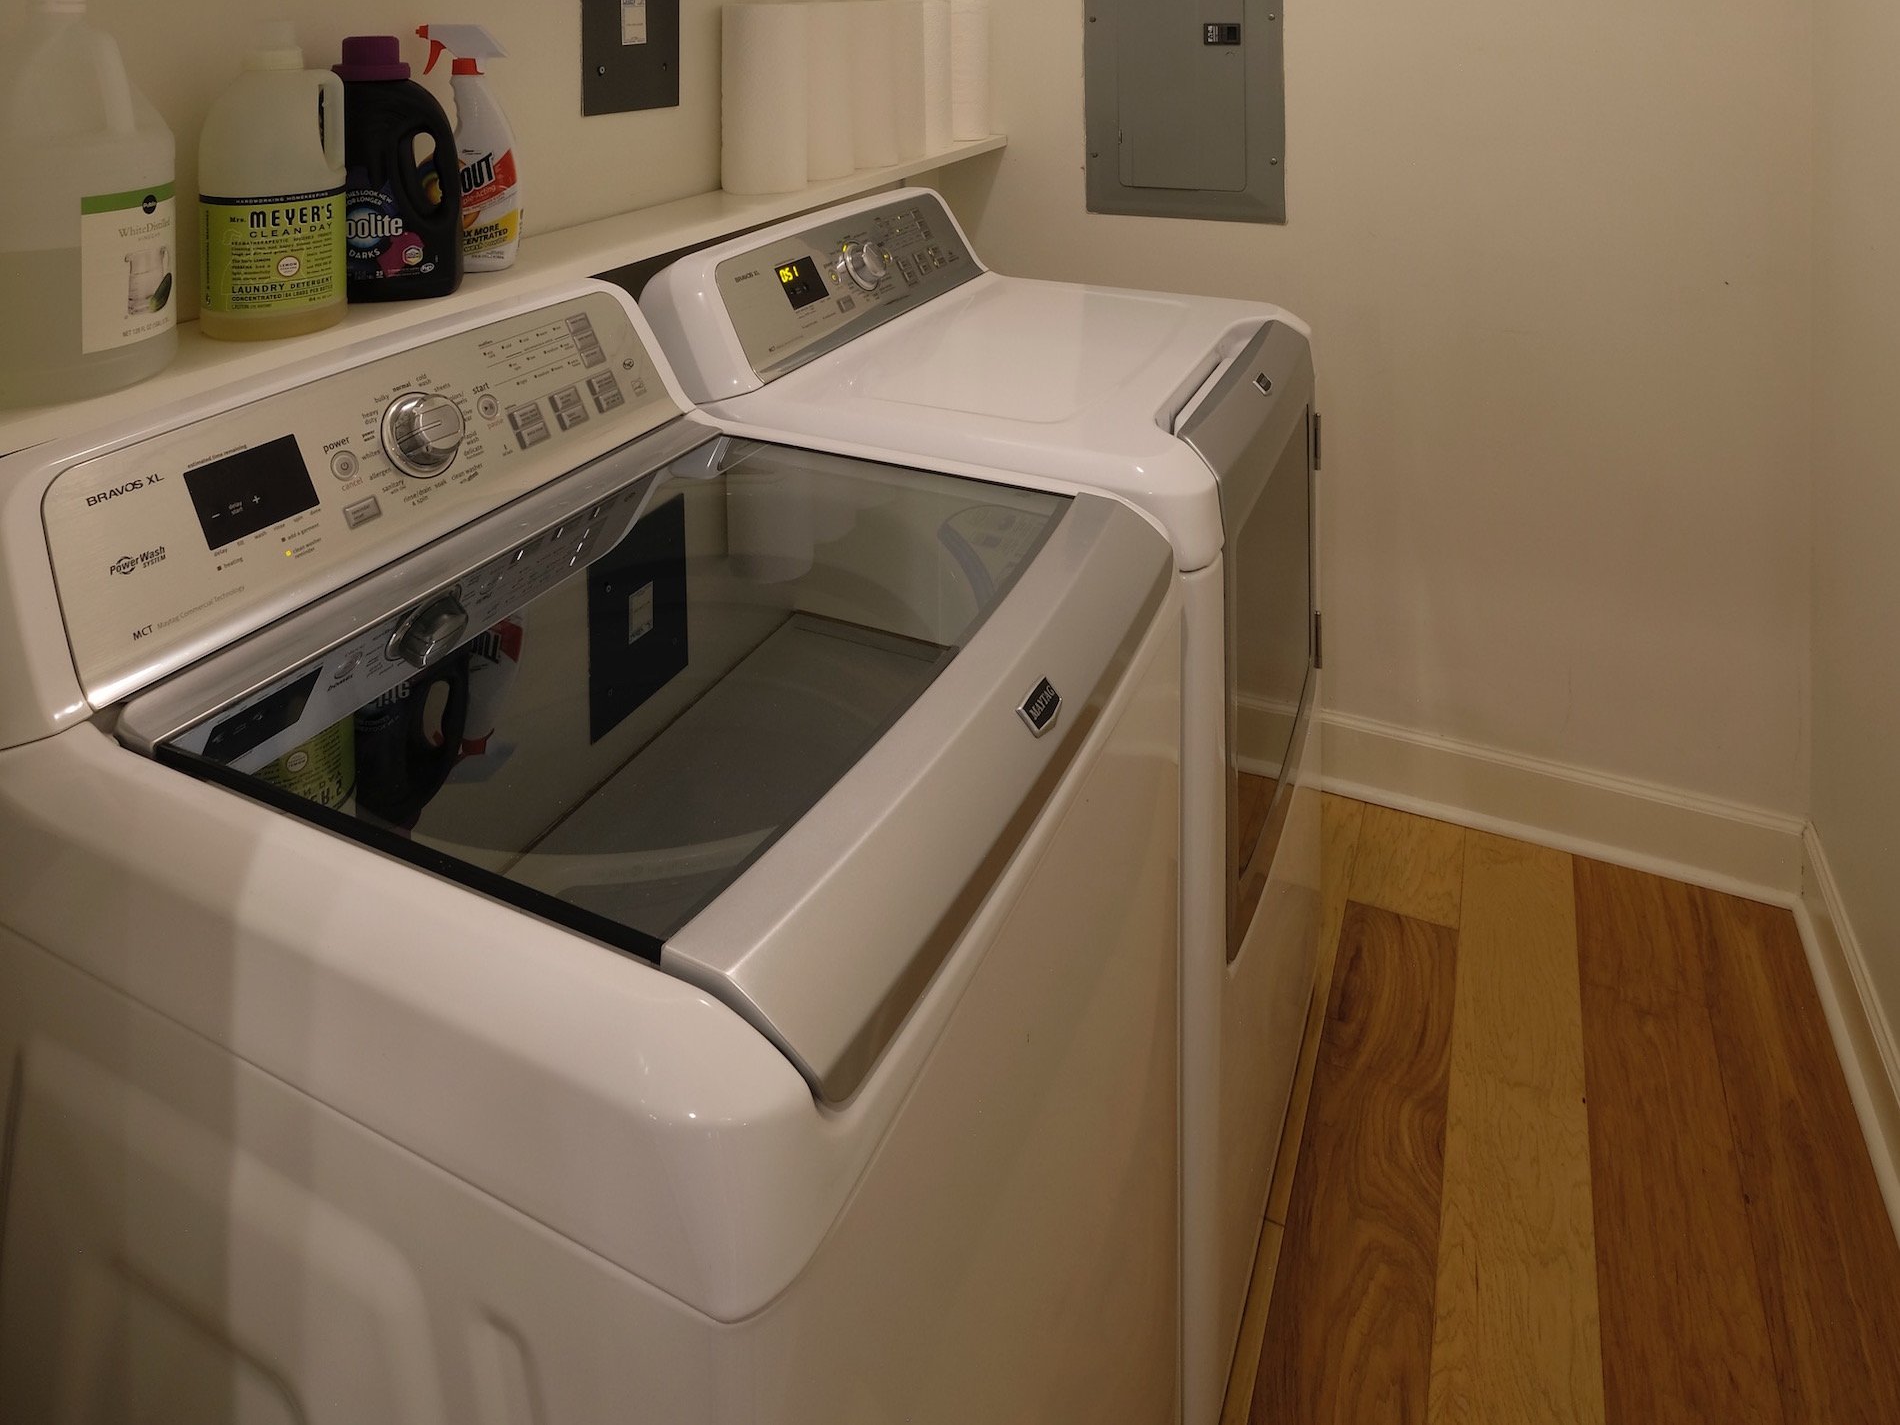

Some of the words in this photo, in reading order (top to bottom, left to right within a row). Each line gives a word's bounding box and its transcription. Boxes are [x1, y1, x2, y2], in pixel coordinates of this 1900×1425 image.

[461, 152, 493, 194] OUT
[286, 191, 329, 201] HOMEKEEPING
[356, 196, 382, 205] LONGER
[360, 189, 378, 197] LOOK
[379, 193, 393, 203] NEW
[249, 203, 333, 229] MEYER'S
[249, 227, 302, 238] CLEAN
[309, 222, 332, 233] DAY
[474, 223, 500, 237] MORE
[349, 248, 381, 259] DARKS
[231, 283, 285, 294] LAUNDRY
[290, 276, 333, 289] DETERGENT
[231, 293, 282, 302] CONCENTRATED
[392, 381, 412, 392] normal
[472, 382, 490, 395] start
[374, 393, 390, 404] bulky
[361, 408, 379, 419] heavy
[364, 417, 378, 426] duty
[361, 430, 375, 438] power
[363, 435, 375, 443] wash
[323, 436, 351, 455] power
[463, 444, 483, 457] delicate
[187, 456, 212, 469] estimated
[223, 444, 247, 456] remaining
[361, 449, 381, 461] whites
[369, 467, 392, 480] allergen
[451, 469, 466, 481] clean
[465, 462, 484, 473] washer
[86, 479, 144, 507] BRAVOS
[146, 473, 165, 486] XL
[341, 477, 364, 492] cancel
[381, 479, 405, 494] sanitary
[434, 479, 447, 488] soak
[403, 486, 432, 503] rinse/drain
[305, 537, 322, 547] washer
[109, 545, 166, 576] PowerWash
[142, 554, 166, 569] SYSTEM
[132, 624, 153, 641] MCT
[156, 616, 180, 629] Maytag
[179, 599, 214, 619] Commercial
[213, 585, 245, 603] Technology
[1028, 685, 1055, 721] MAYTAG
